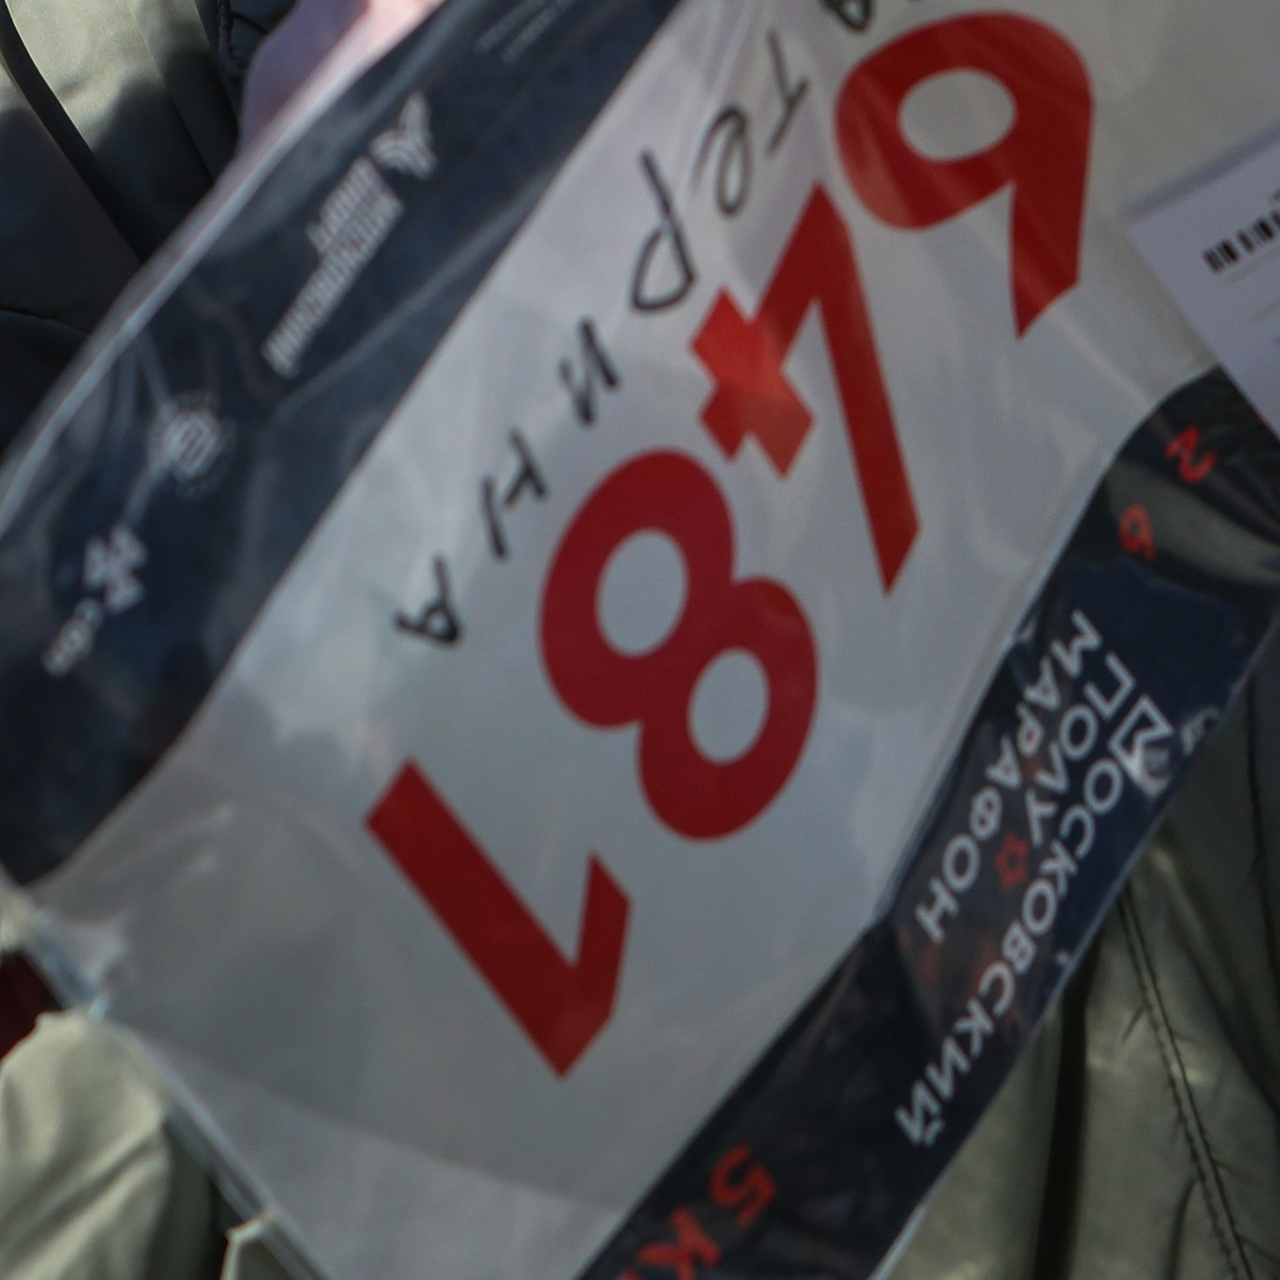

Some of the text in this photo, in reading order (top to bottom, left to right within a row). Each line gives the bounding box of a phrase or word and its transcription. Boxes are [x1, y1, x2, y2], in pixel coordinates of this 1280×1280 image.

[367, 10, 1094, 1077] 6481
[914, 608, 1104, 943] МАРАФОН
[1026, 652, 1137, 848] ПОЛУ
[895, 694, 1175, 1147] МОСКОВСКИЙ
[618, 1143, 778, 1280] 5 К
